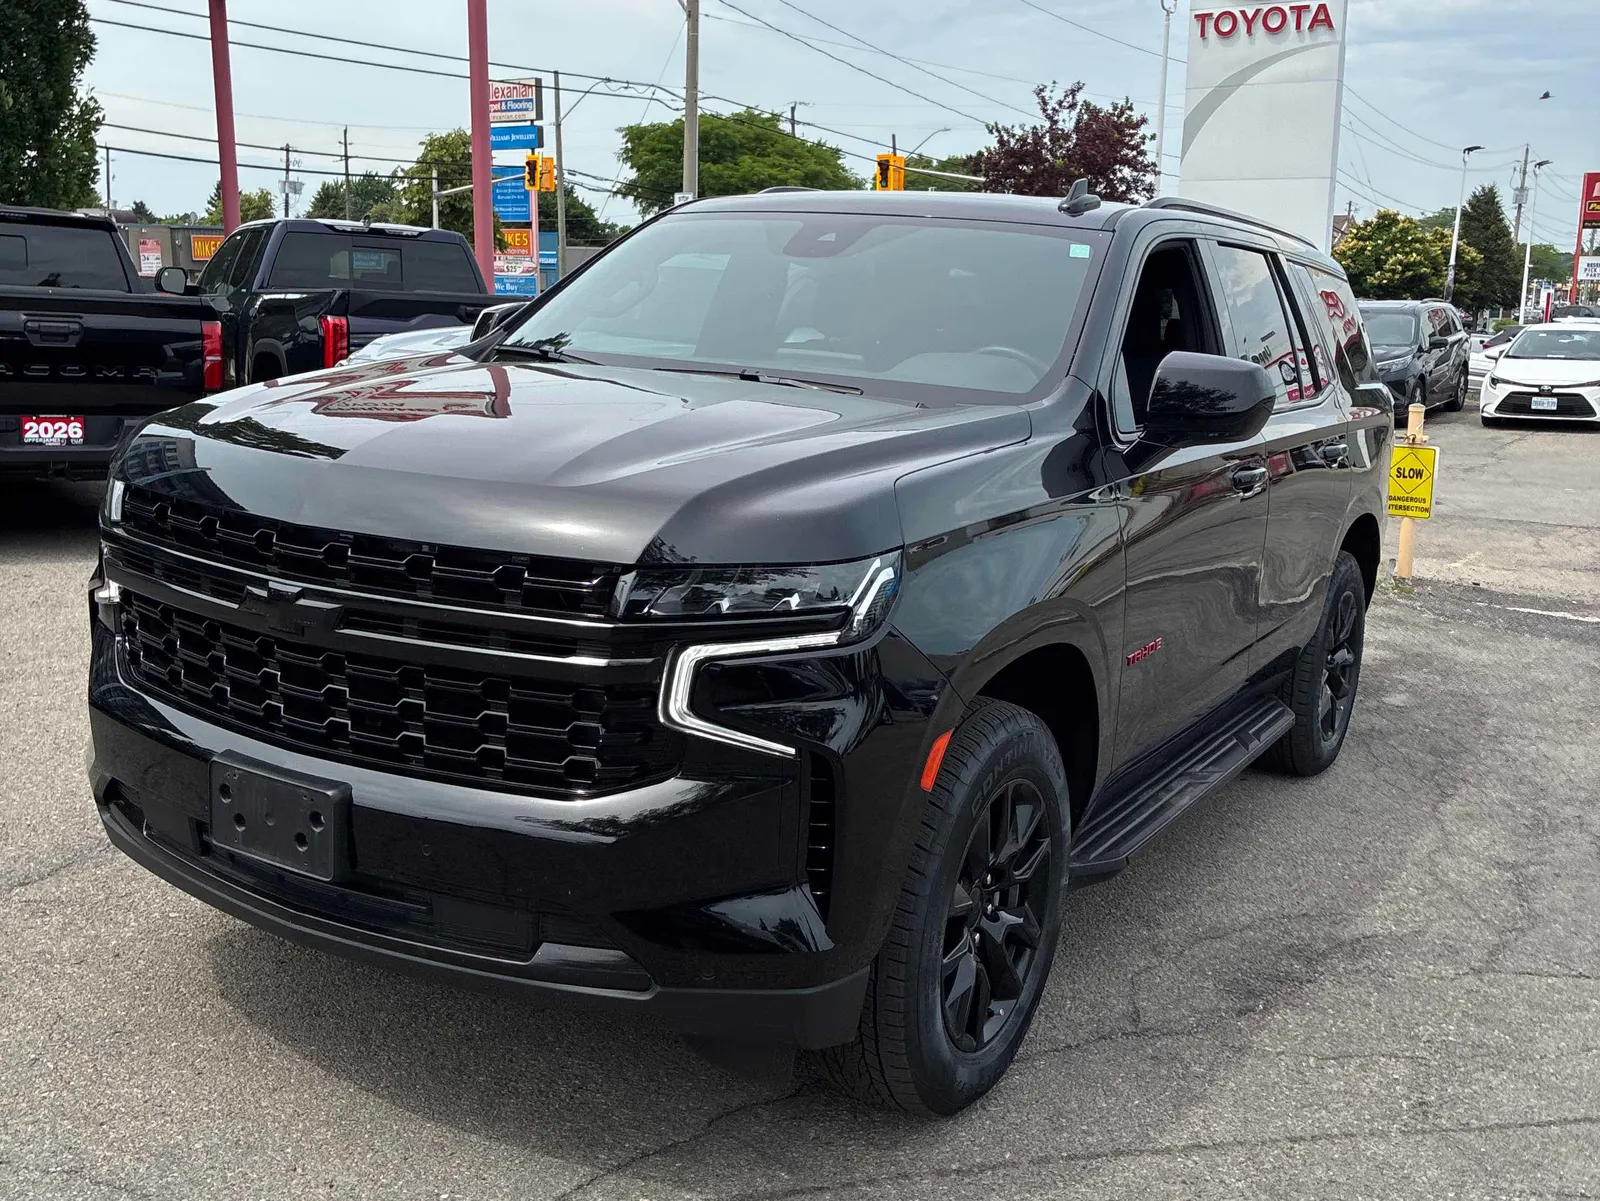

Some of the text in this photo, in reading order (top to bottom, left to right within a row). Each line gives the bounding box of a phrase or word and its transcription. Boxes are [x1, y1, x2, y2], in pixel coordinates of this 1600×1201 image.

[1194, 3, 1334, 39] TOYOTA
[491, 83, 534, 99] lexanian
[501, 101, 506, 110] &
[507, 101, 533, 111] Flooring
[504, 233, 528, 246] IKE'S
[505, 283, 519, 293] Buy
[24, 421, 83, 438] 2026
[1395, 467, 1424, 480] SLOW
[1388, 495, 1427, 504] DANGEROUS
[1388, 503, 1430, 513] TERSECTION
[1126, 637, 1162, 667] TAHOE
